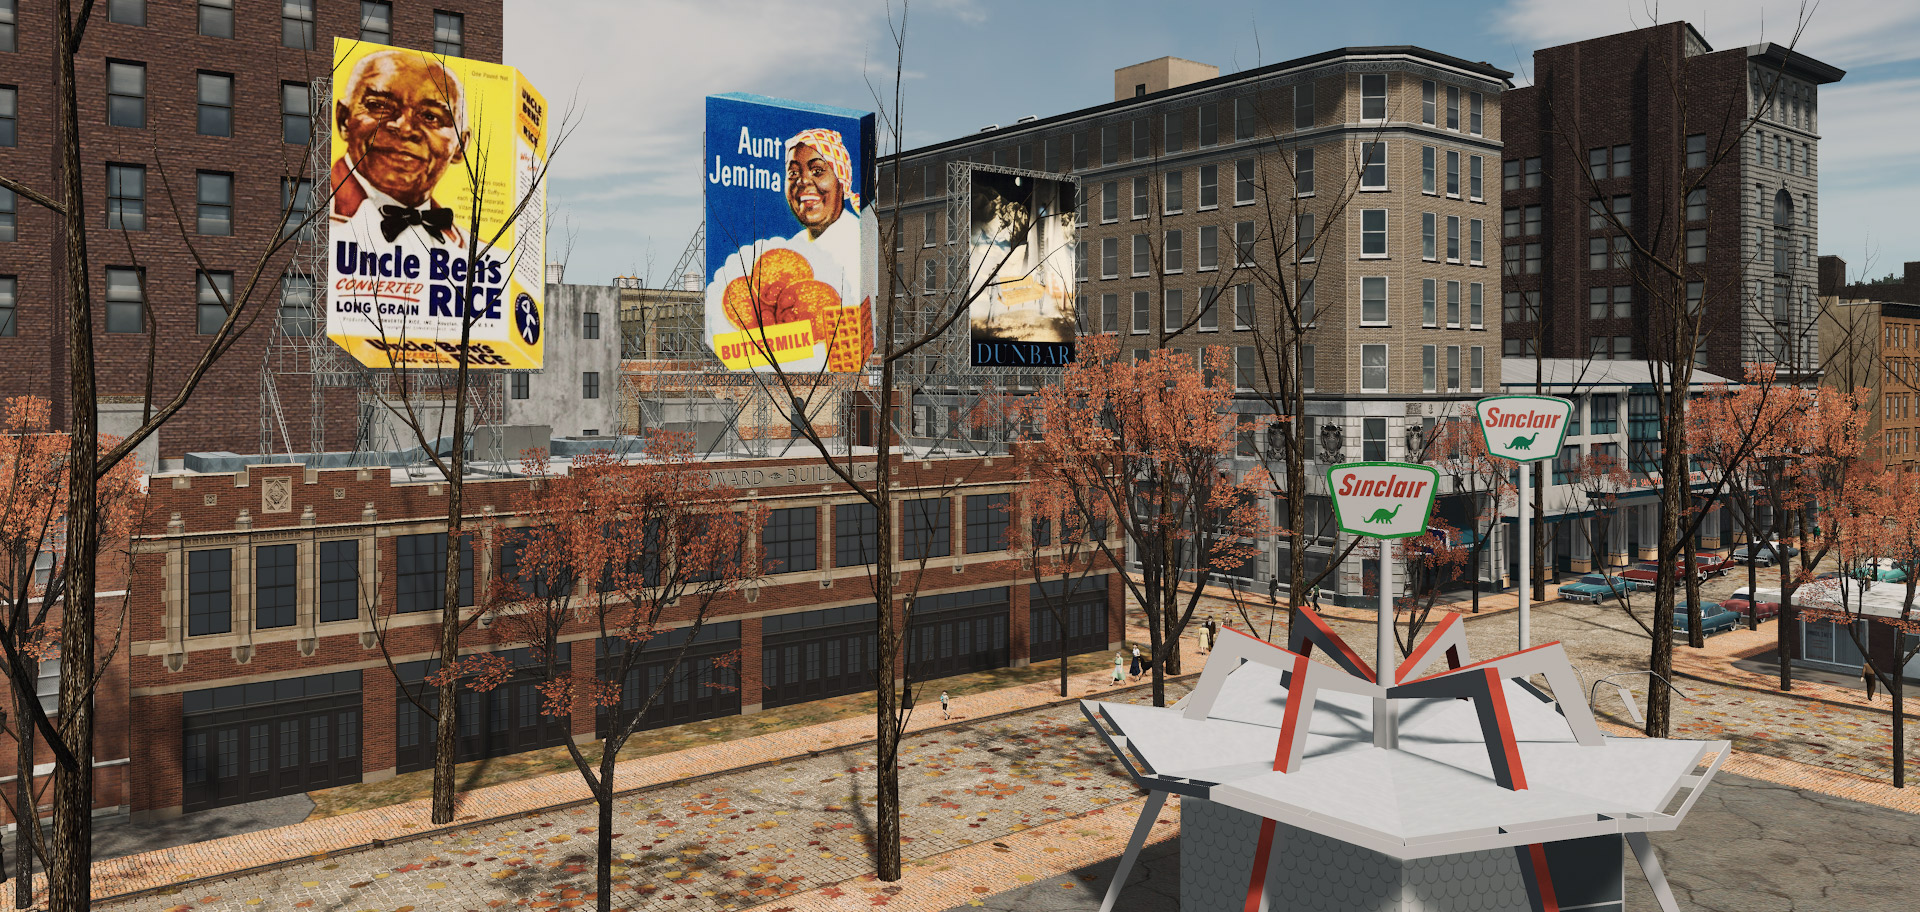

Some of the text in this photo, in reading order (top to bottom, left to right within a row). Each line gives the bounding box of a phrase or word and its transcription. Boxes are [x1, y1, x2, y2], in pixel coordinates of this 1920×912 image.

[522, 87, 541, 117] UNCLE
[738, 126, 782, 160] Aunt
[709, 155, 781, 192] Jemima
[336, 240, 420, 279] Uncle
[430, 248, 502, 284] Ben's
[336, 278, 424, 294] CONVERTED
[336, 301, 419, 315] LONG GRAIN
[429, 284, 502, 319] RICE
[364, 338, 437, 353] Uncle
[721, 332, 811, 360] BUTTERMILK
[976, 343, 1070, 365] DUNBAR
[1485, 407, 1561, 430] Sinclair
[700, 464, 867, 489] OWARD BUILDNG
[1338, 473, 1428, 499] Sinclair
